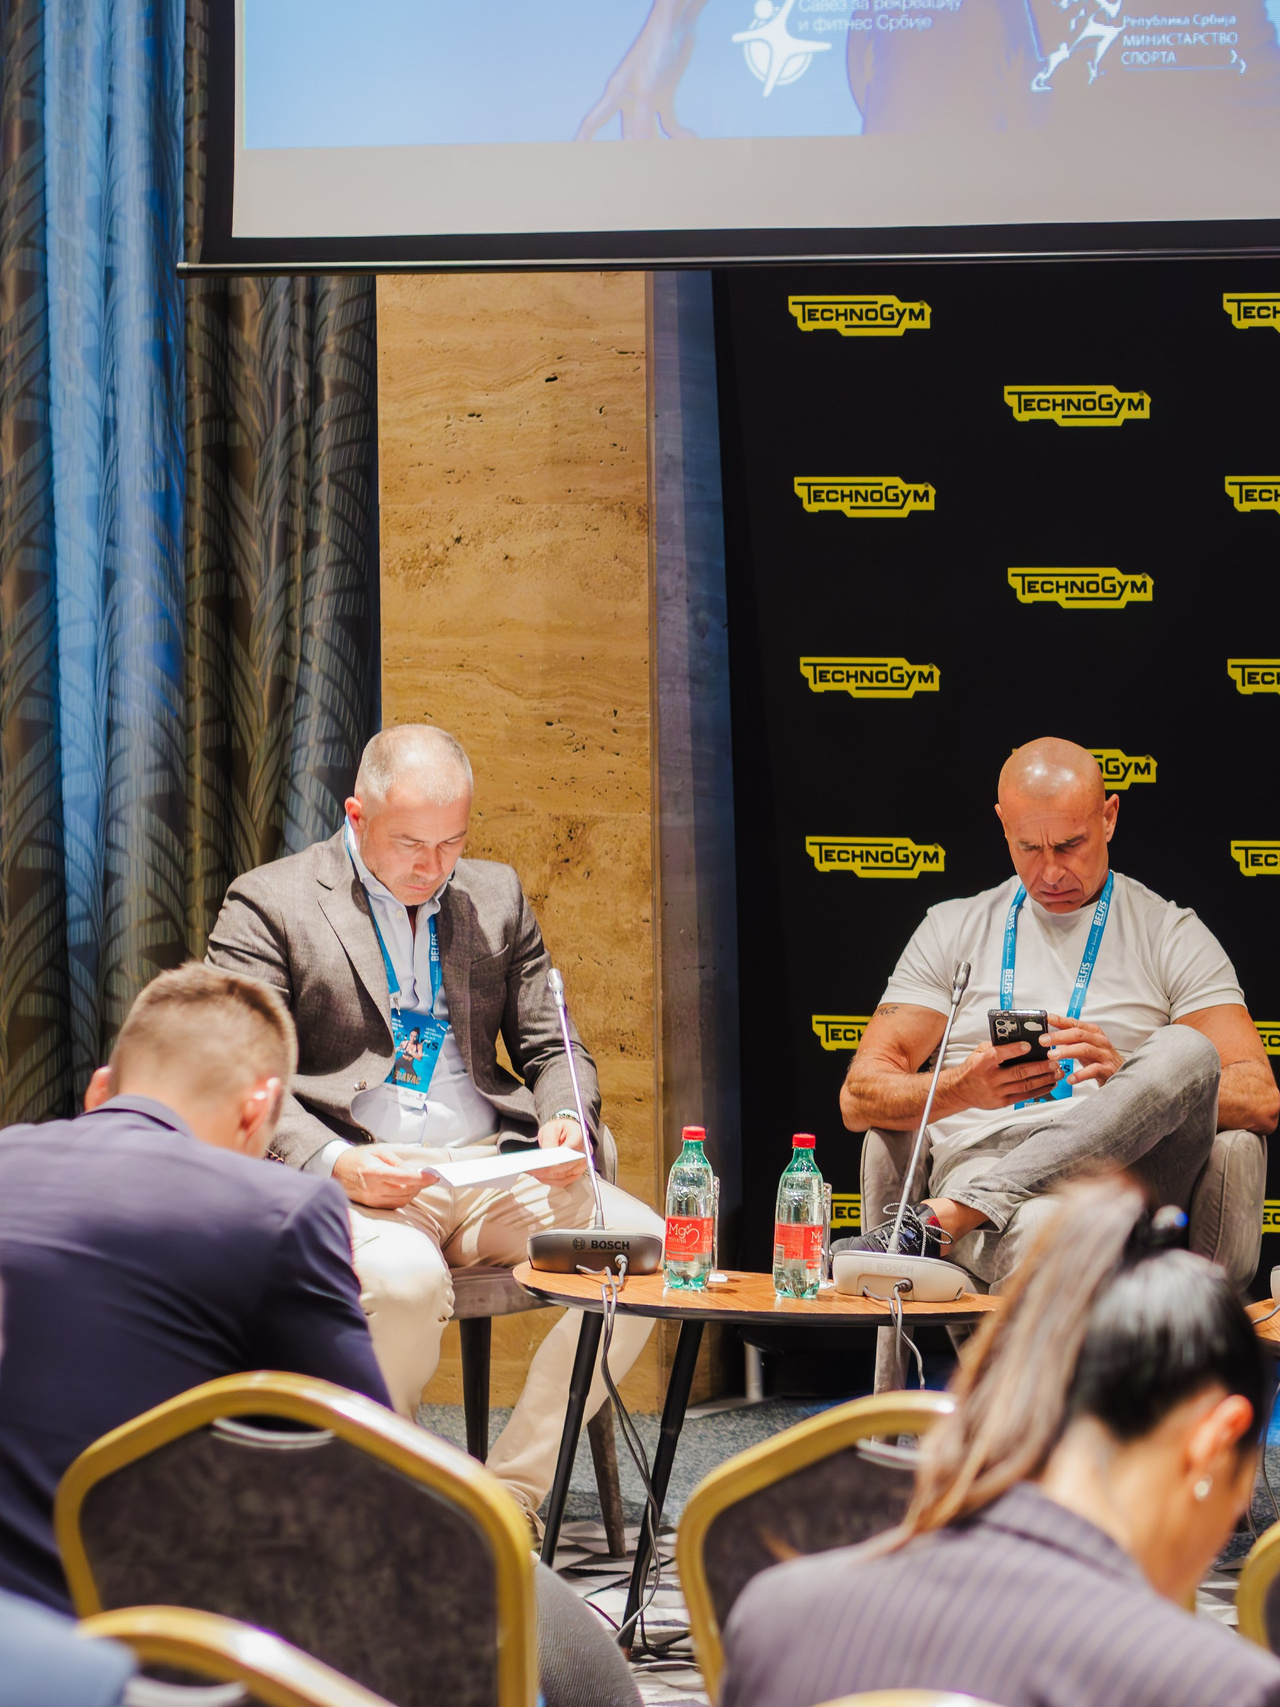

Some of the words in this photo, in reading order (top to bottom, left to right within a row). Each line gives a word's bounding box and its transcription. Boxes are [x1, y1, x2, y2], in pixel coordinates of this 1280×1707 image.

[813, 17, 873, 34] фитнес
[876, 14, 933, 33] Србије
[1122, 14, 1190, 29] Република
[1193, 13, 1236, 27] Србија
[1122, 32, 1238, 47] МИНИСТАРСТВО
[1120, 51, 1176, 65] СПОРТА
[1093, 900, 1108, 927] BELFIS
[1003, 968, 1014, 995] BELFIS
[1076, 962, 1092, 989] BELFIS
[590, 1240, 630, 1251] BOSCH
[877, 1263, 914, 1275] BOSCH
